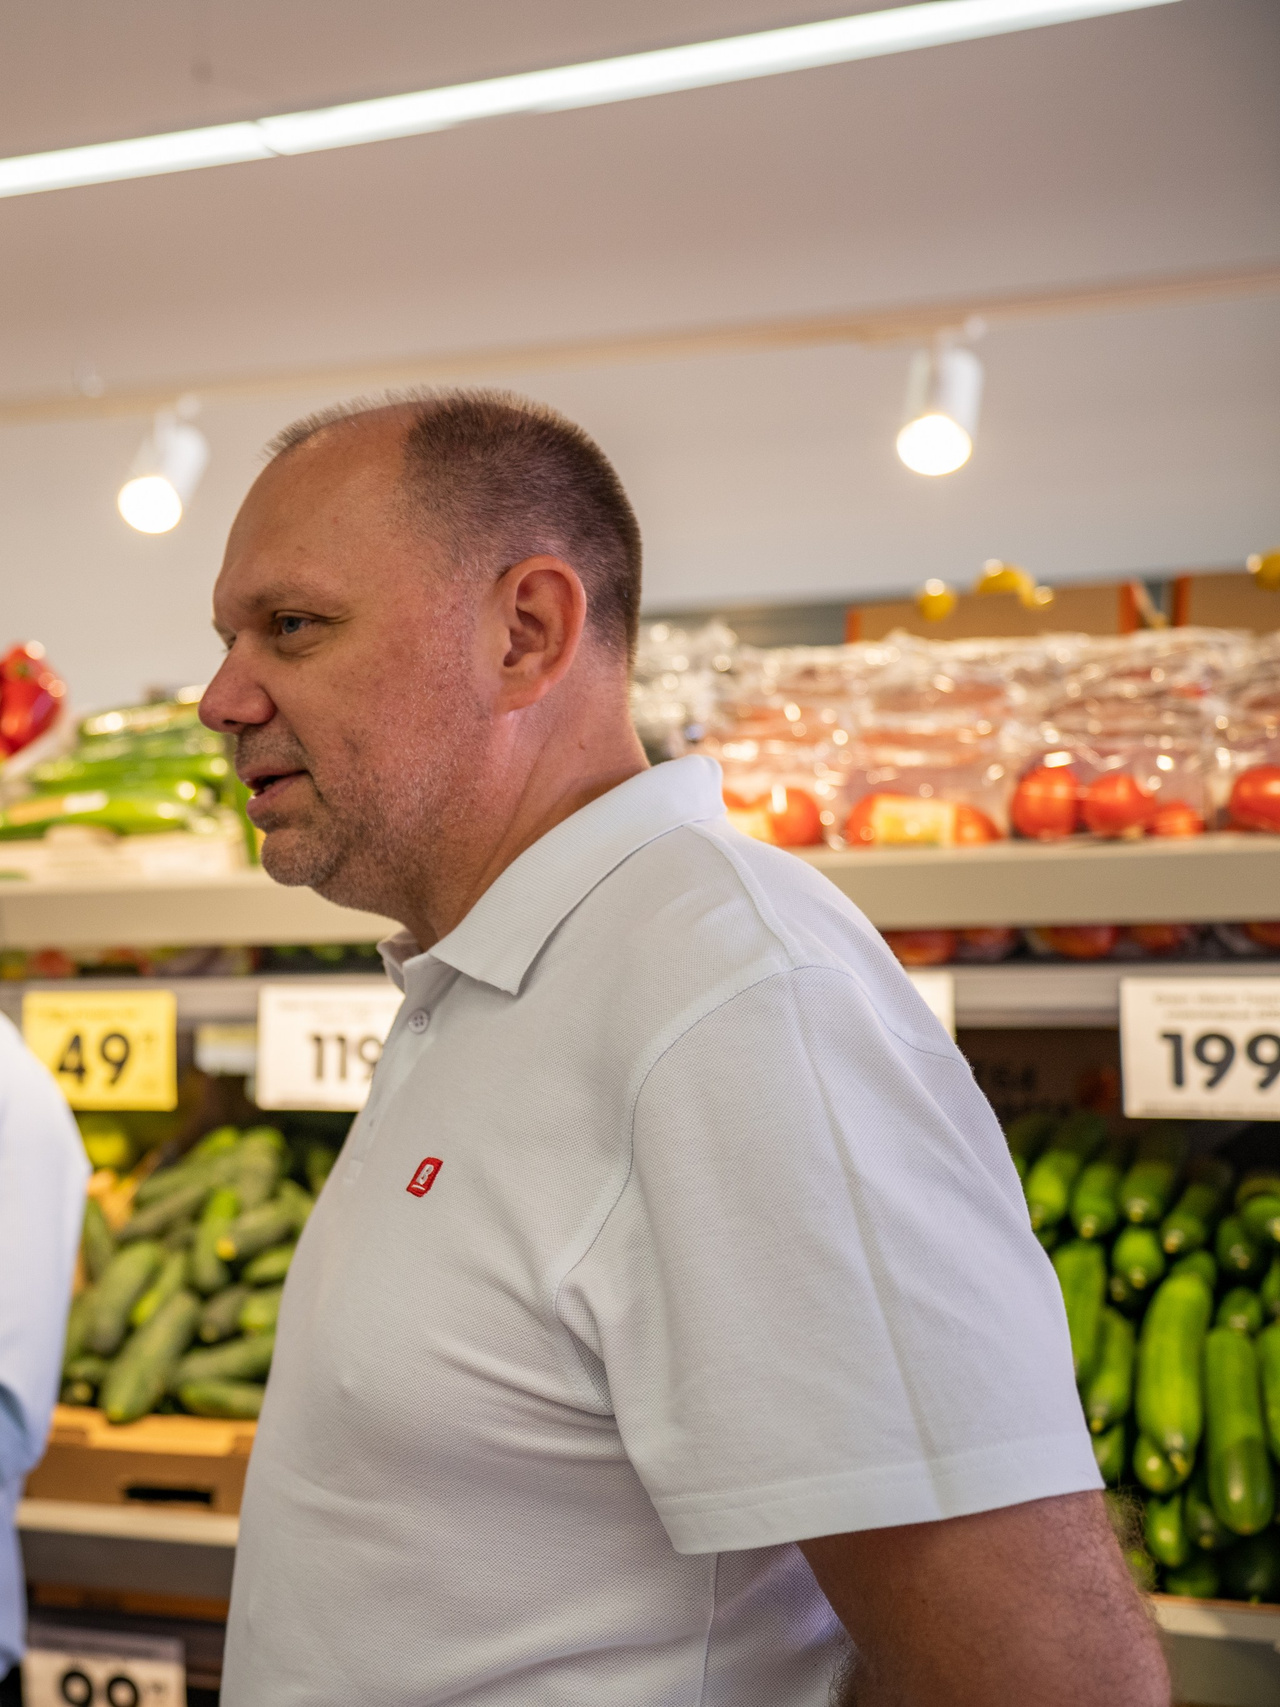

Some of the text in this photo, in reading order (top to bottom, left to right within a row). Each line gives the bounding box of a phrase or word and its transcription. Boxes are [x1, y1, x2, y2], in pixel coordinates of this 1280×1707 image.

[57, 1033, 131, 1087] 49
[311, 1034, 383, 1081] 119
[1160, 1033, 1280, 1089] 199
